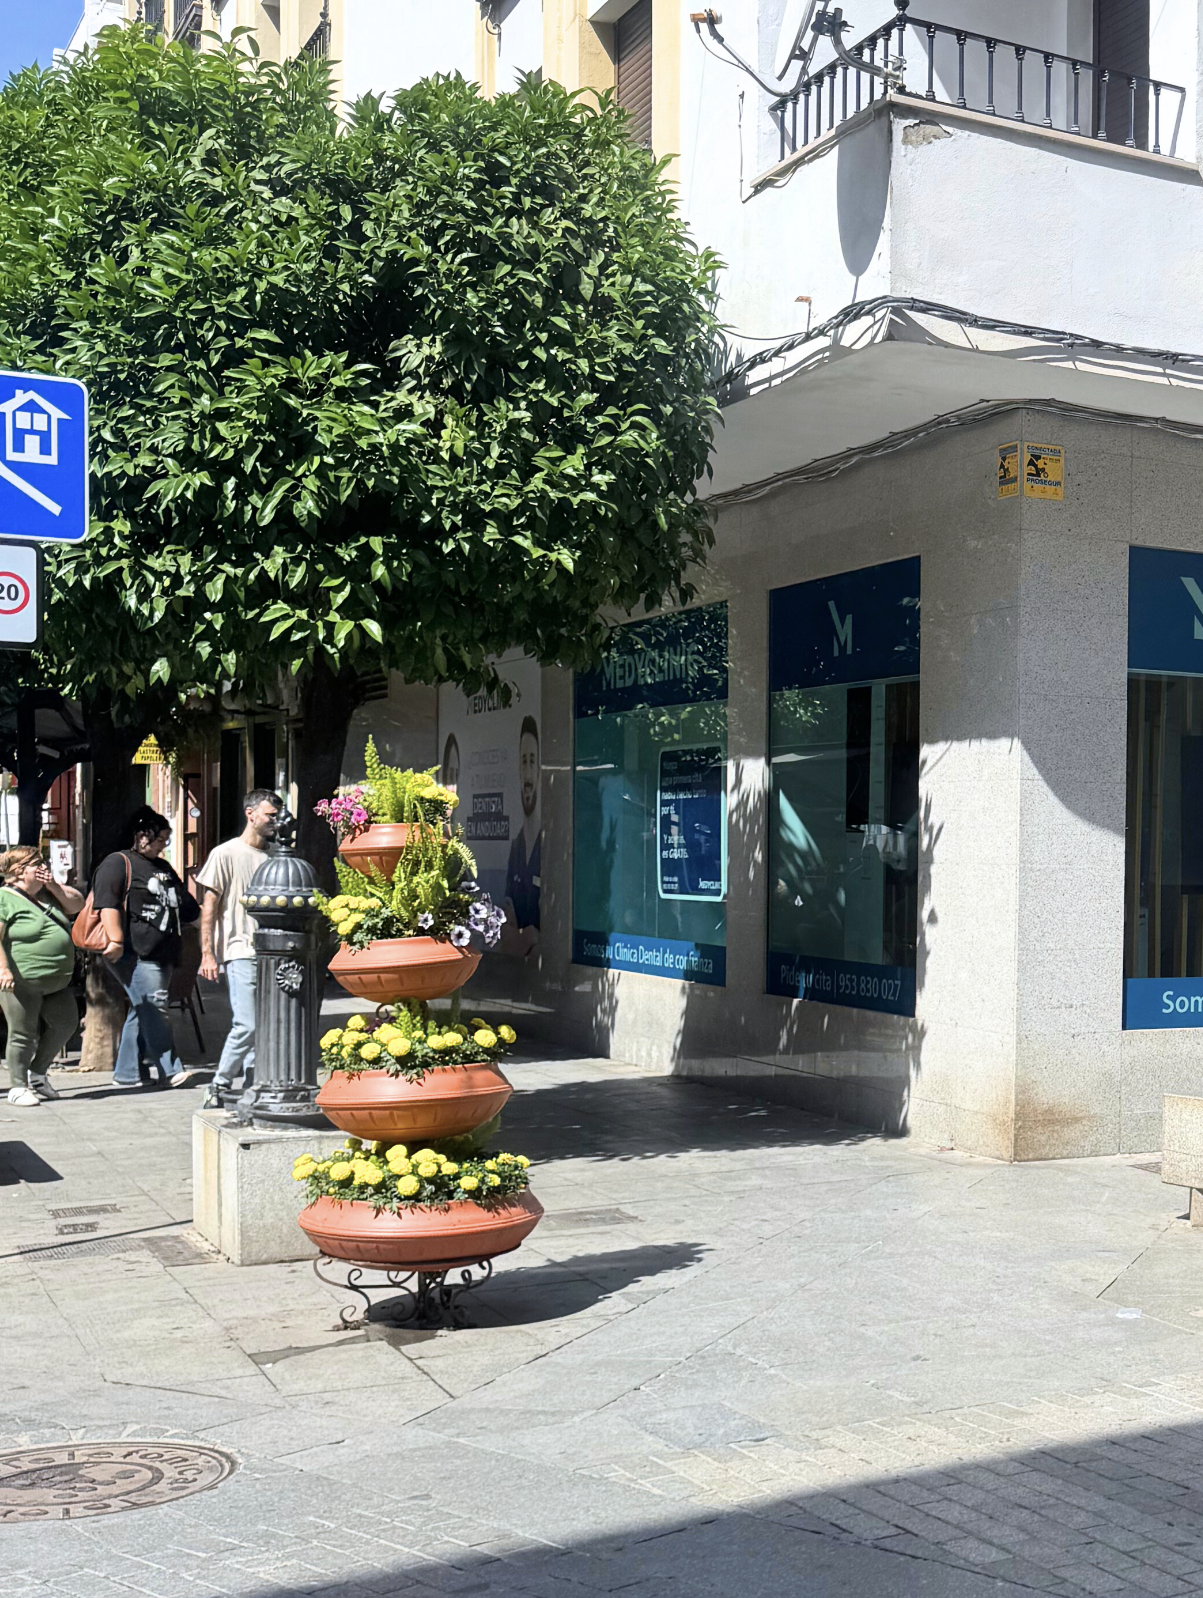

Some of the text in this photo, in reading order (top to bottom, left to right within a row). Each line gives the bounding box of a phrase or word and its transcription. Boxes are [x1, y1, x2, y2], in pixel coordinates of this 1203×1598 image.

[1026, 477, 1062, 487] PROSEGUR
[474, 797, 502, 813] DENTISTA
[583, 939, 713, 973] Somos tu Clínica Dental de confianza
[781, 964, 901, 1000] Pide tu cita 953 830 027
